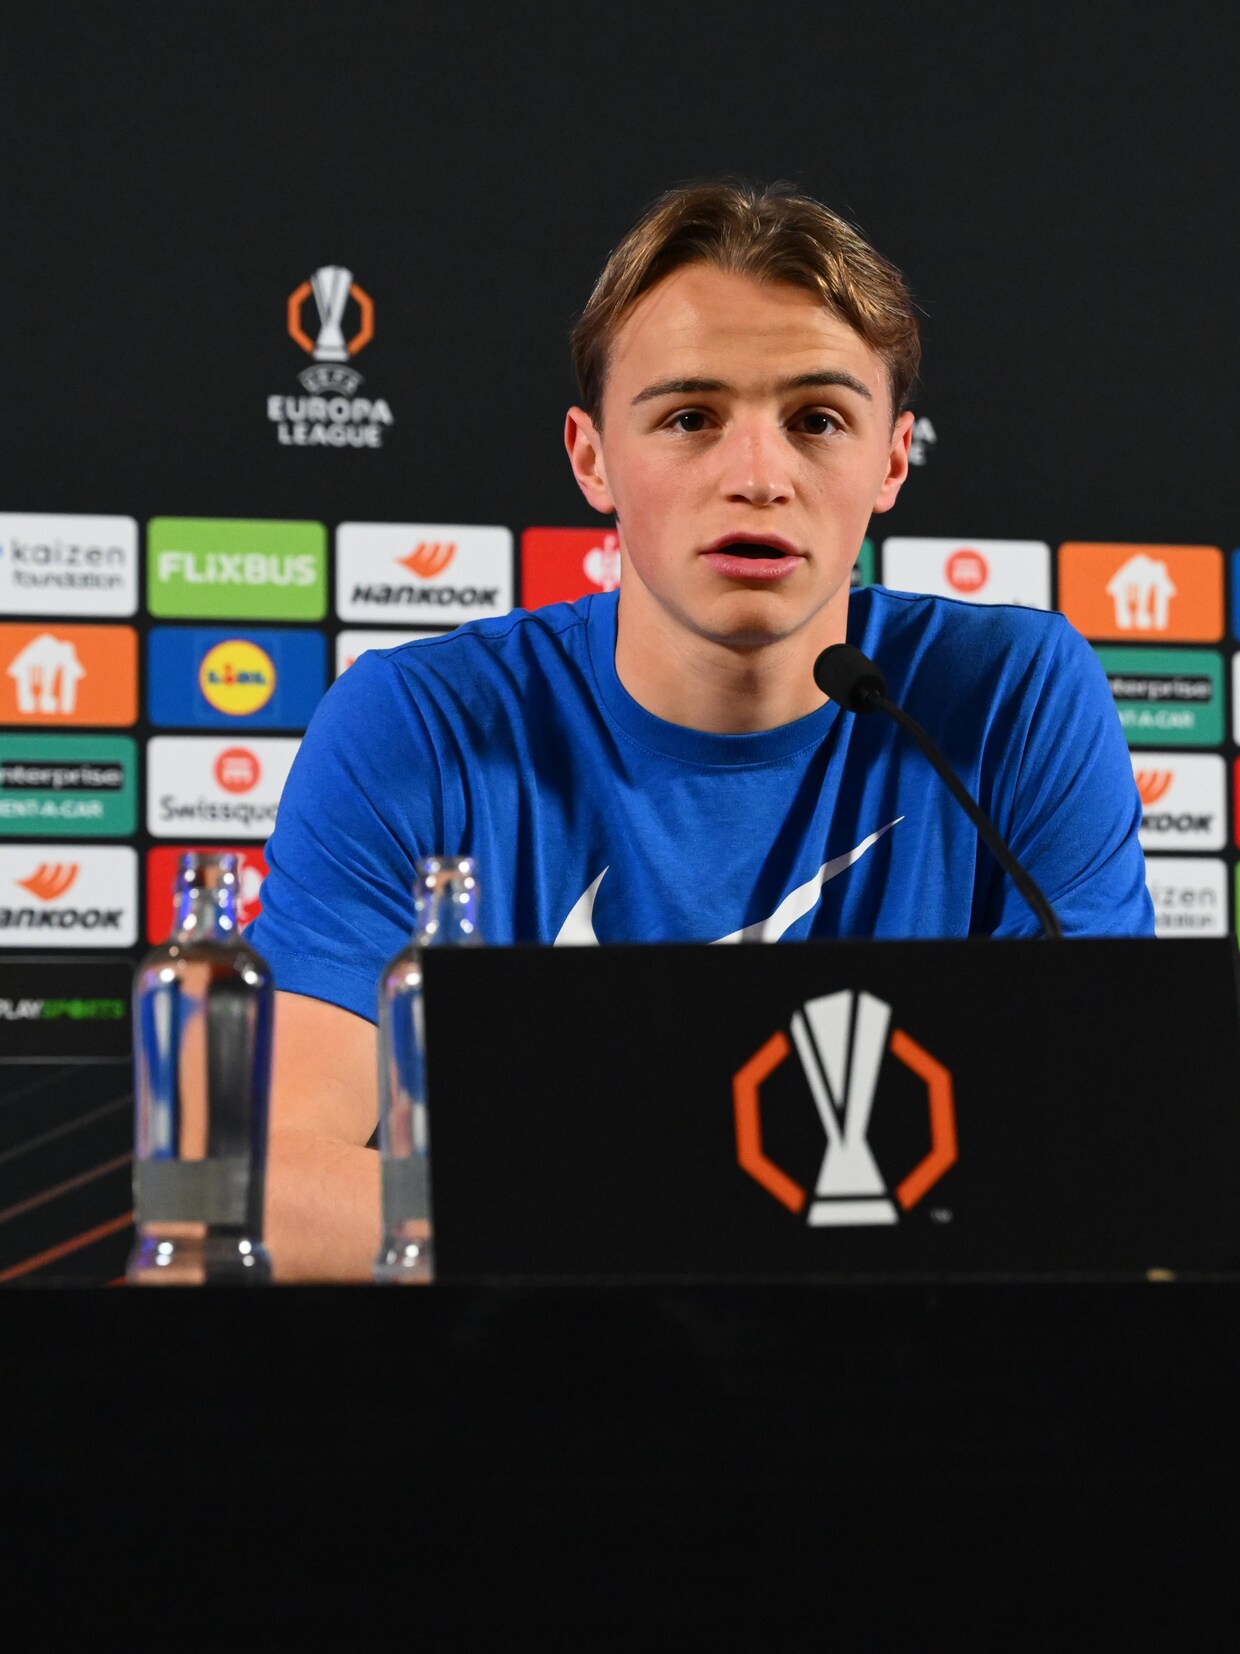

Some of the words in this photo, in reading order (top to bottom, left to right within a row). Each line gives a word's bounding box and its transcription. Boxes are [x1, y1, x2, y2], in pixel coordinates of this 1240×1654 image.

[267, 394, 394, 426] EUROPA
[278, 422, 382, 448] LEAGUE
[10, 538, 126, 566] kaizen
[1110, 678, 1211, 701] terprise
[0, 766, 123, 790] nterprise
[0, 799, 104, 819] ENT-A-CAR
[159, 795, 277, 826] Swissquo
[1151, 880, 1218, 908] izen
